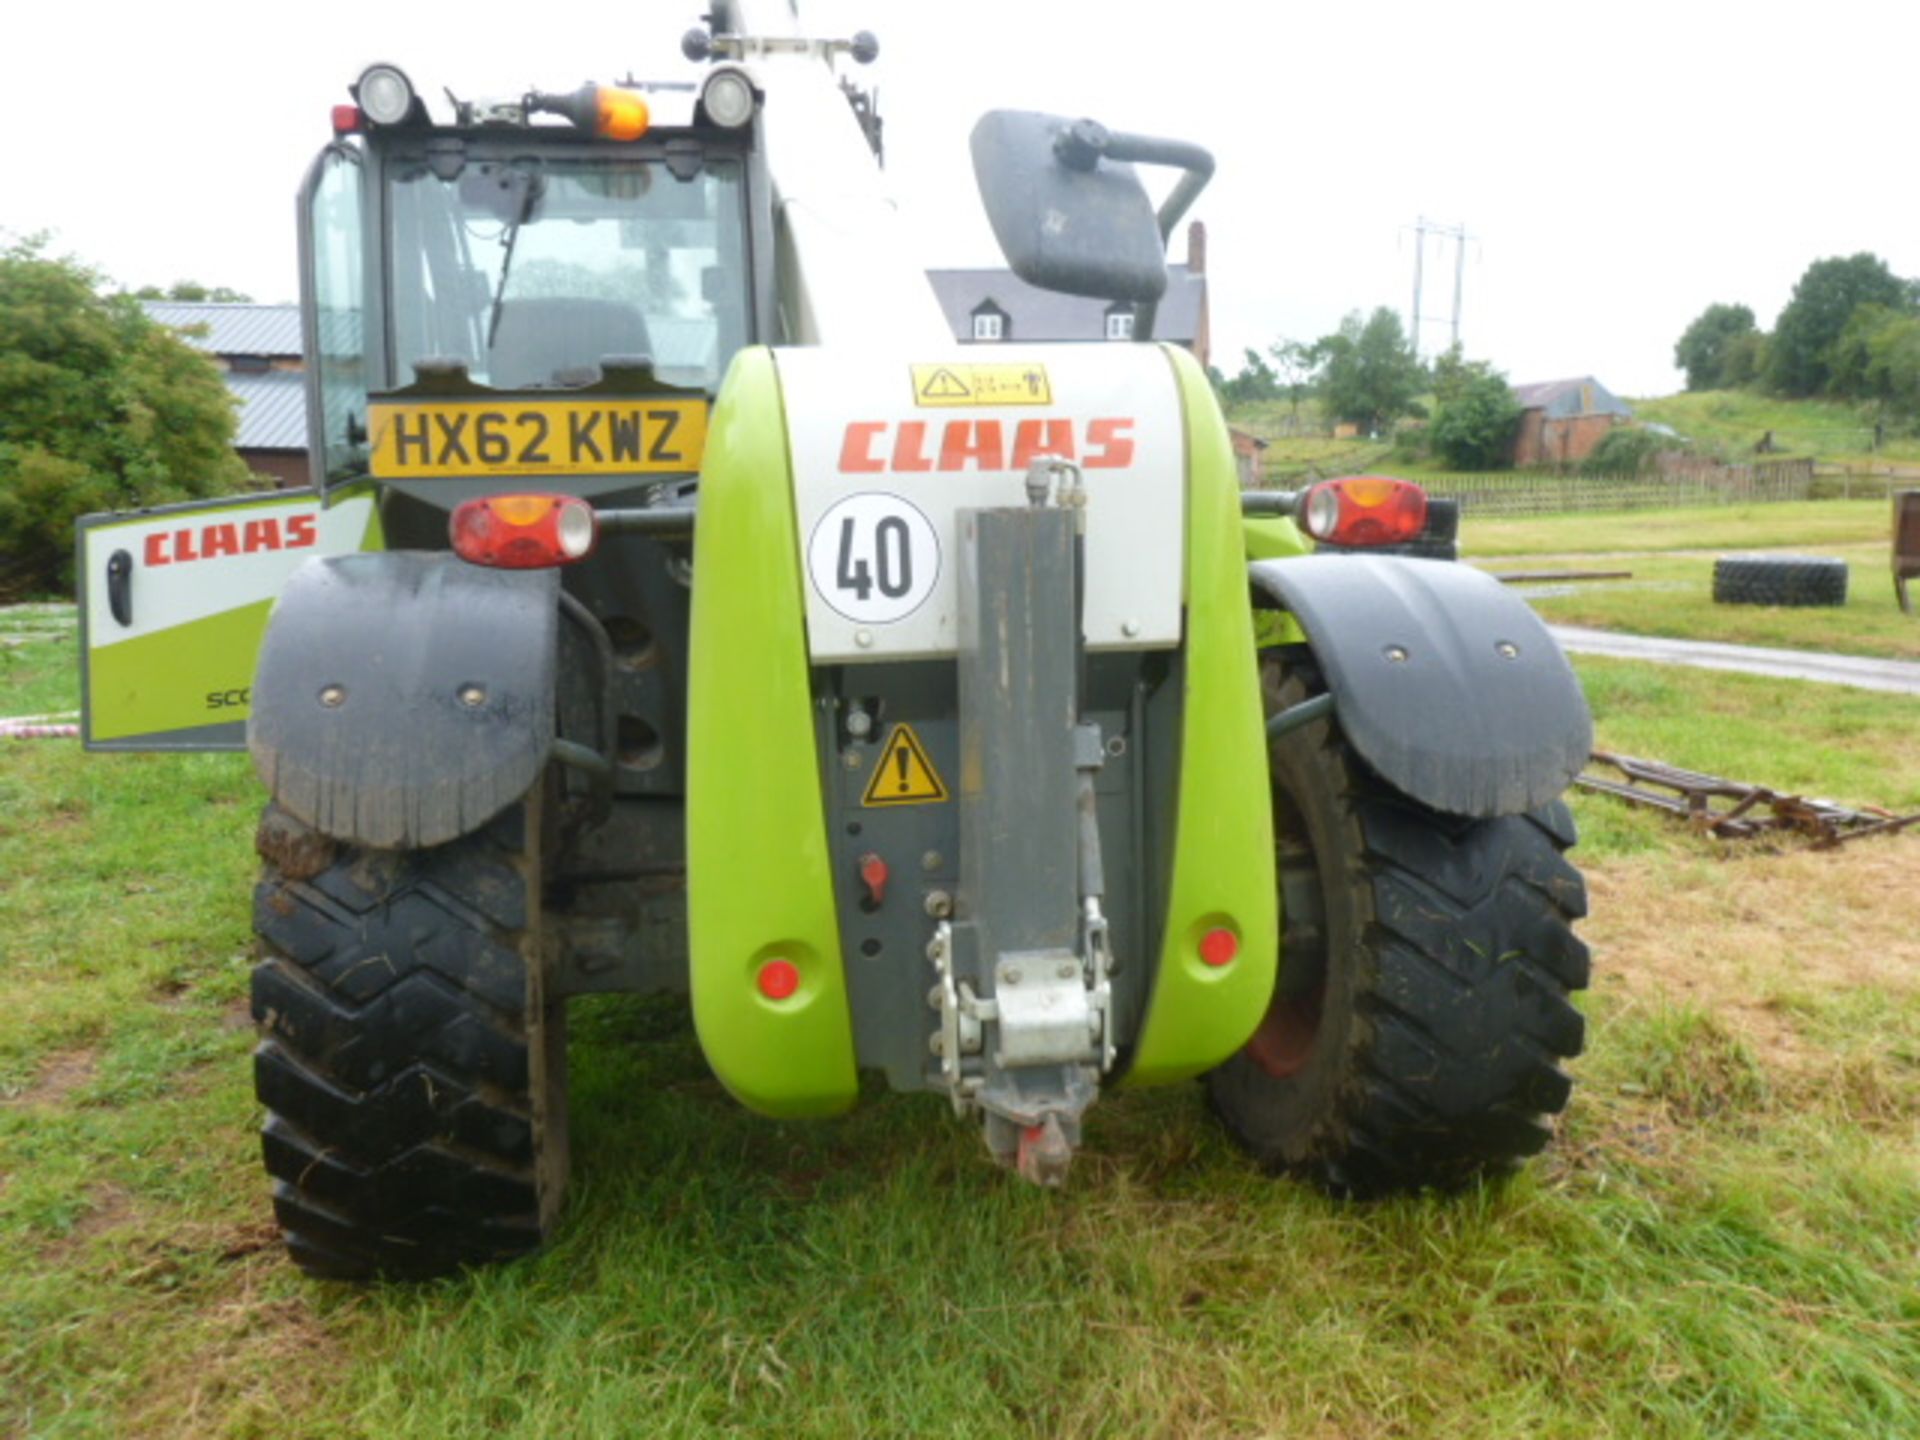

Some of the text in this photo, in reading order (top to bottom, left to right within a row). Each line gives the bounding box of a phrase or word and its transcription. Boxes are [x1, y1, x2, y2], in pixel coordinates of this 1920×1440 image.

[393, 410, 682, 465] HX62 KWZ
[836, 418, 1136, 474] CLAAS
[143, 513, 317, 567] CLAAS
[836, 515, 913, 601] 40
